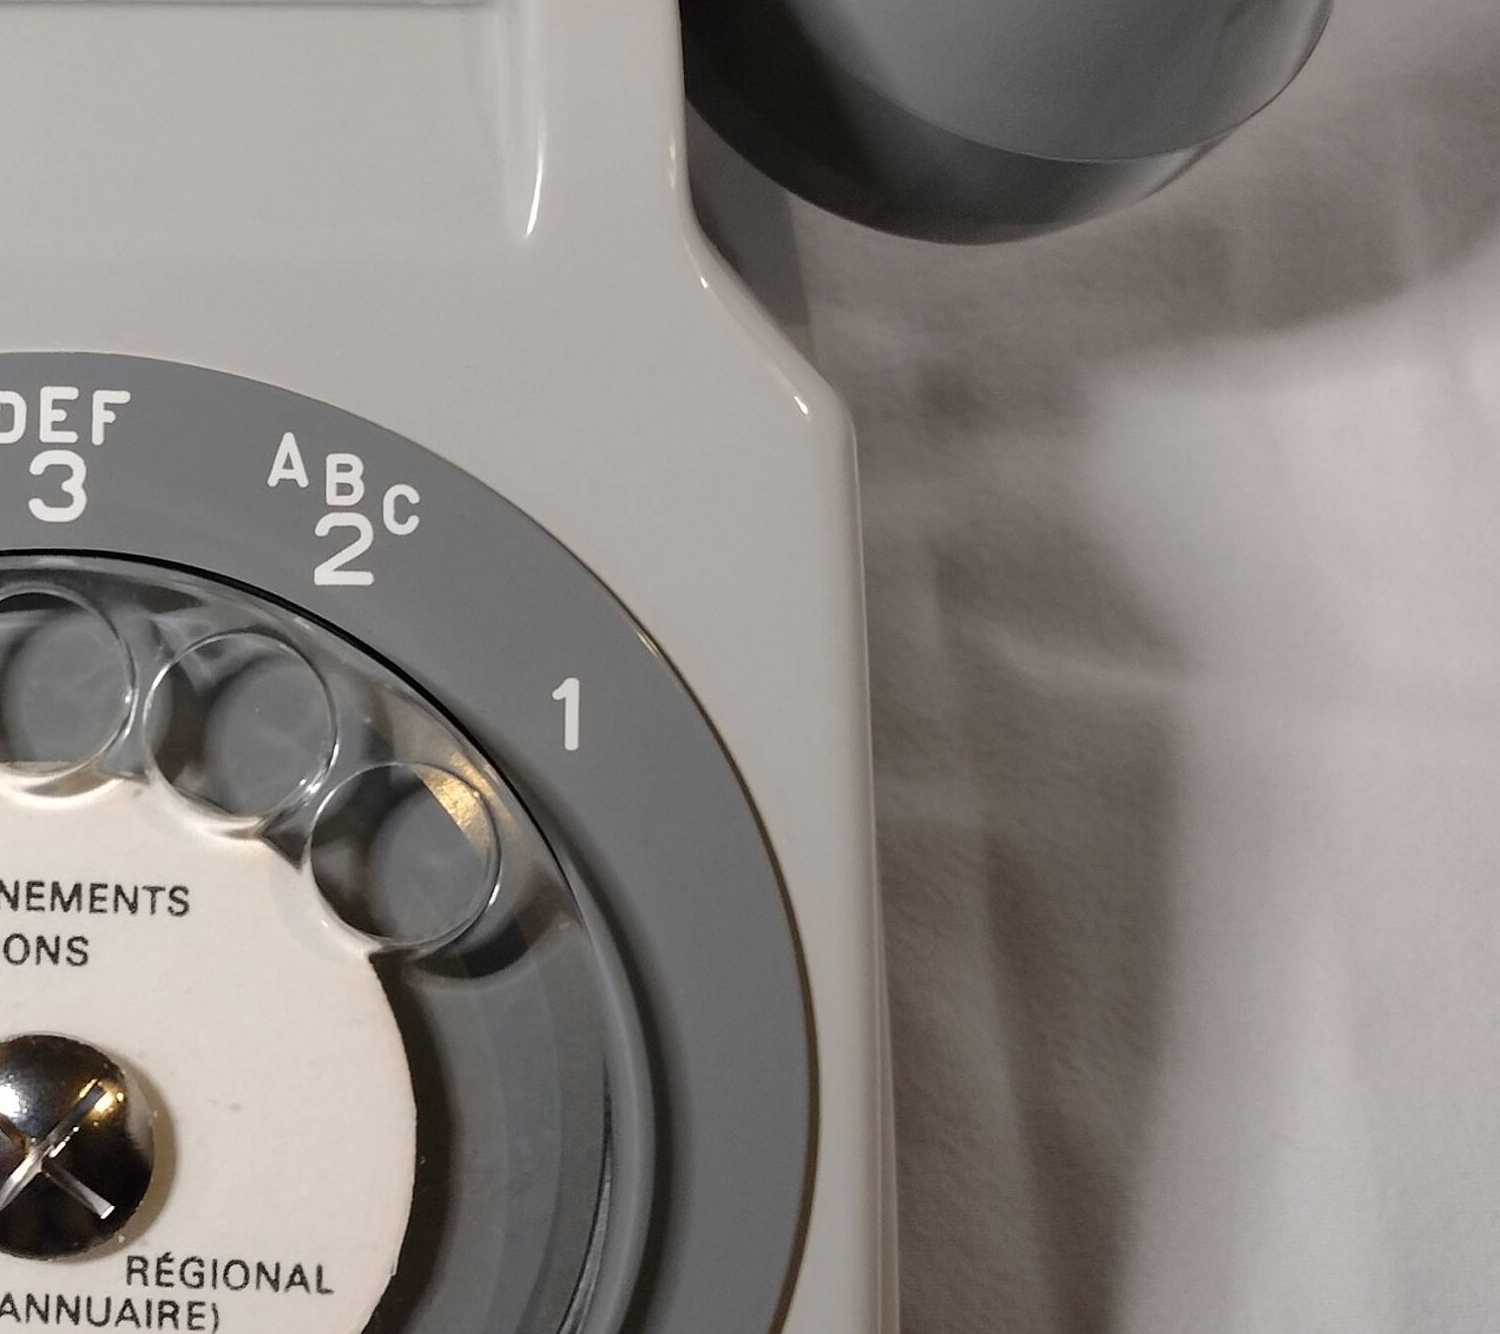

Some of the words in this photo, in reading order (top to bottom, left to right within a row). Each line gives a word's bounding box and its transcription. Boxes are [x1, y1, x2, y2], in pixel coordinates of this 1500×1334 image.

[27, 449, 88, 524] 3
[267, 431, 422, 537] ABC
[313, 511, 375, 586] 2
[551, 677, 582, 751] 1
[126, 1250, 336, 1297] RÉGIONAL
